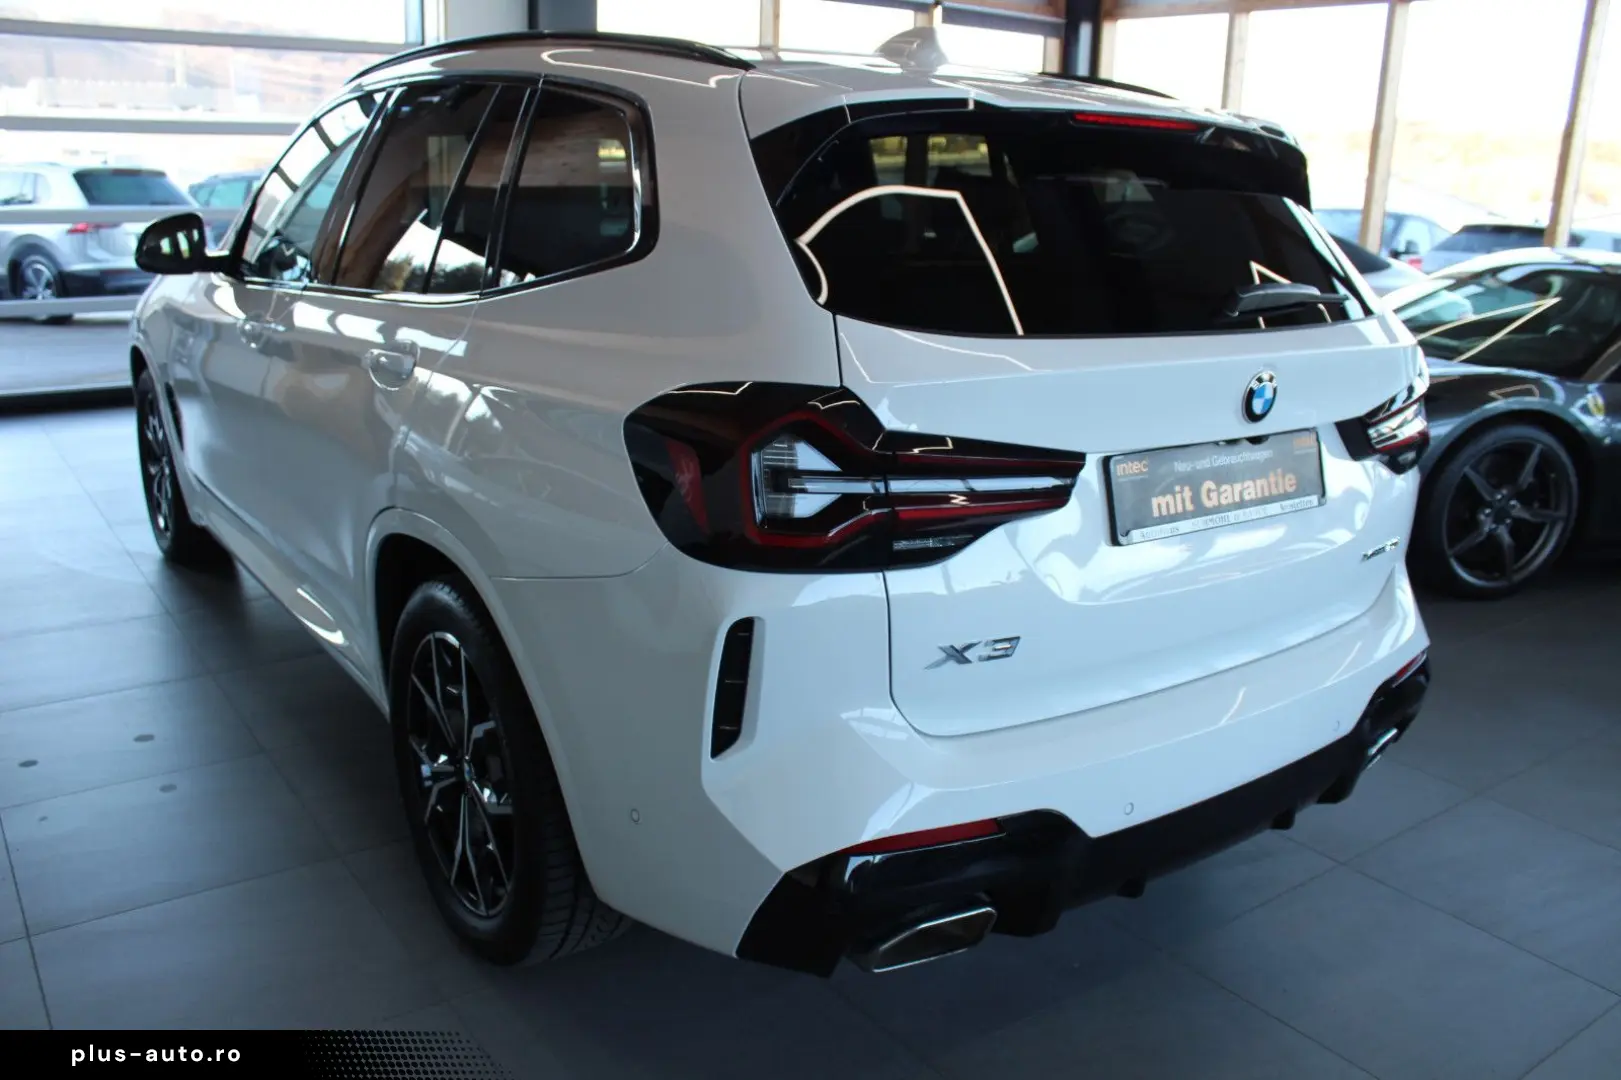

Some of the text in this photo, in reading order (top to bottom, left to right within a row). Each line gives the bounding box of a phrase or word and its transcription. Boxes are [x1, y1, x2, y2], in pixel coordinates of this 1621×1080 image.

[1211, 449, 1274, 467] Gebrauchtwagen
[1151, 467, 1298, 518] mit Garantie
[924, 636, 1021, 670] X3
